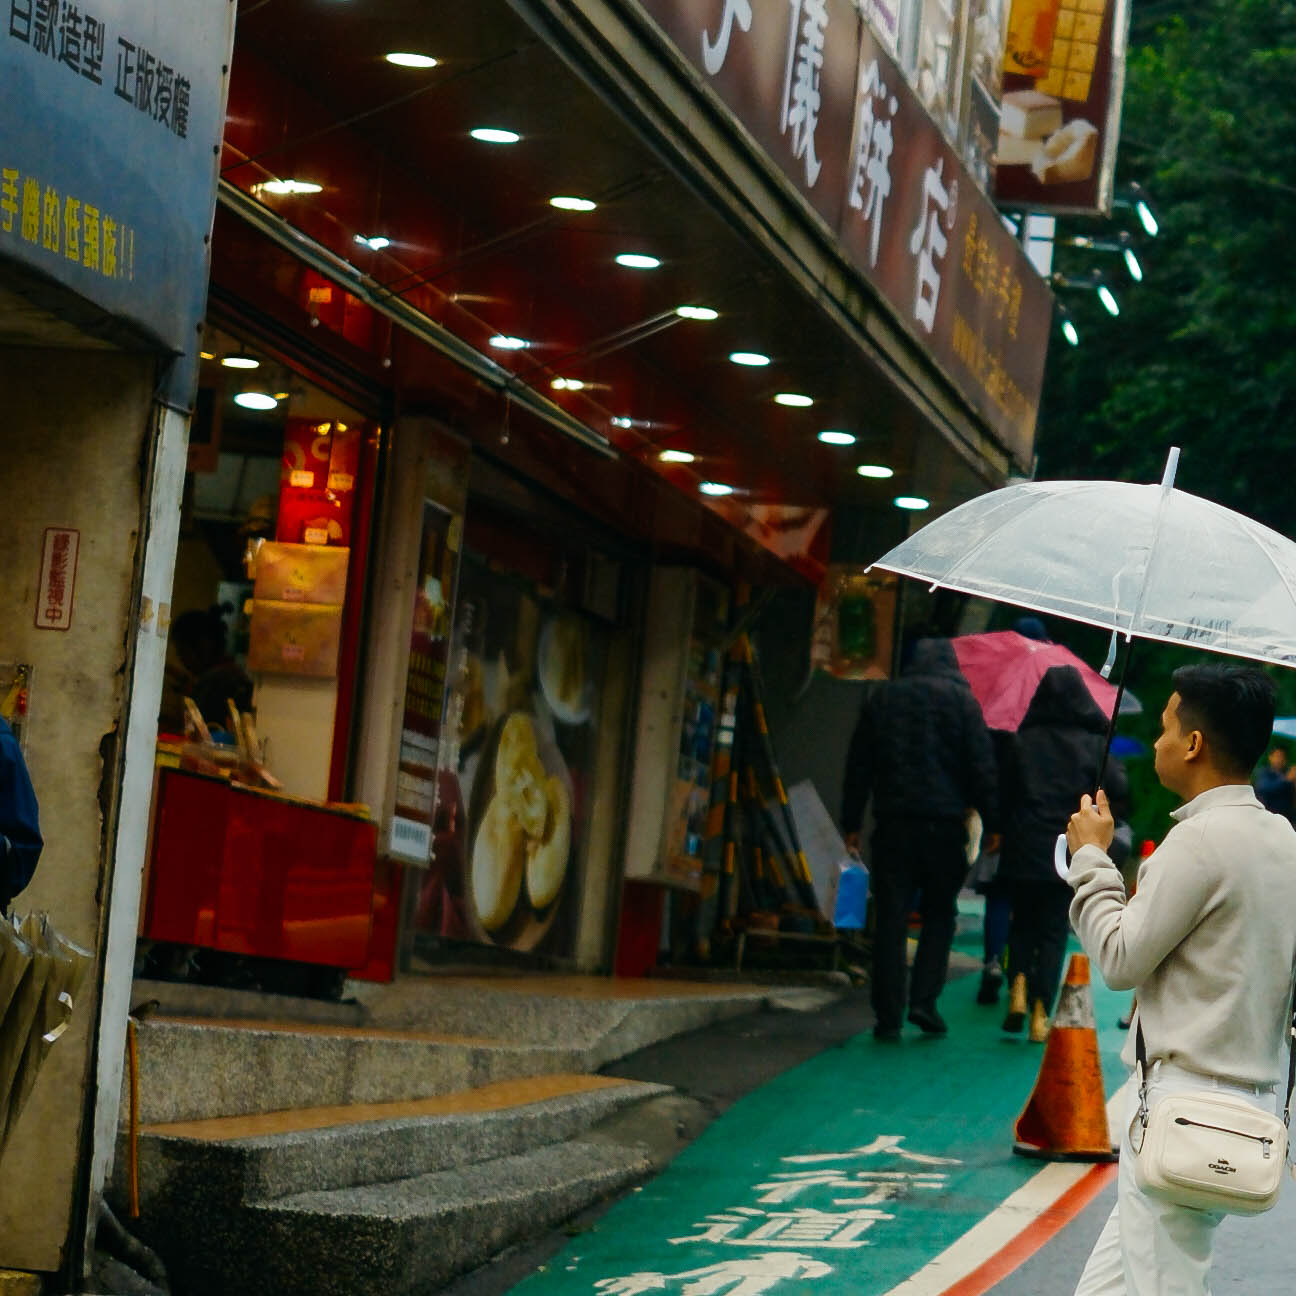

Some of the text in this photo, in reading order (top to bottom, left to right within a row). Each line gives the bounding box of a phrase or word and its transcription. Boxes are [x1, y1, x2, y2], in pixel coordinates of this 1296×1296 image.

[114, 36, 191, 140] 正版授權
[667, 1135, 963, 1249] 人行道
